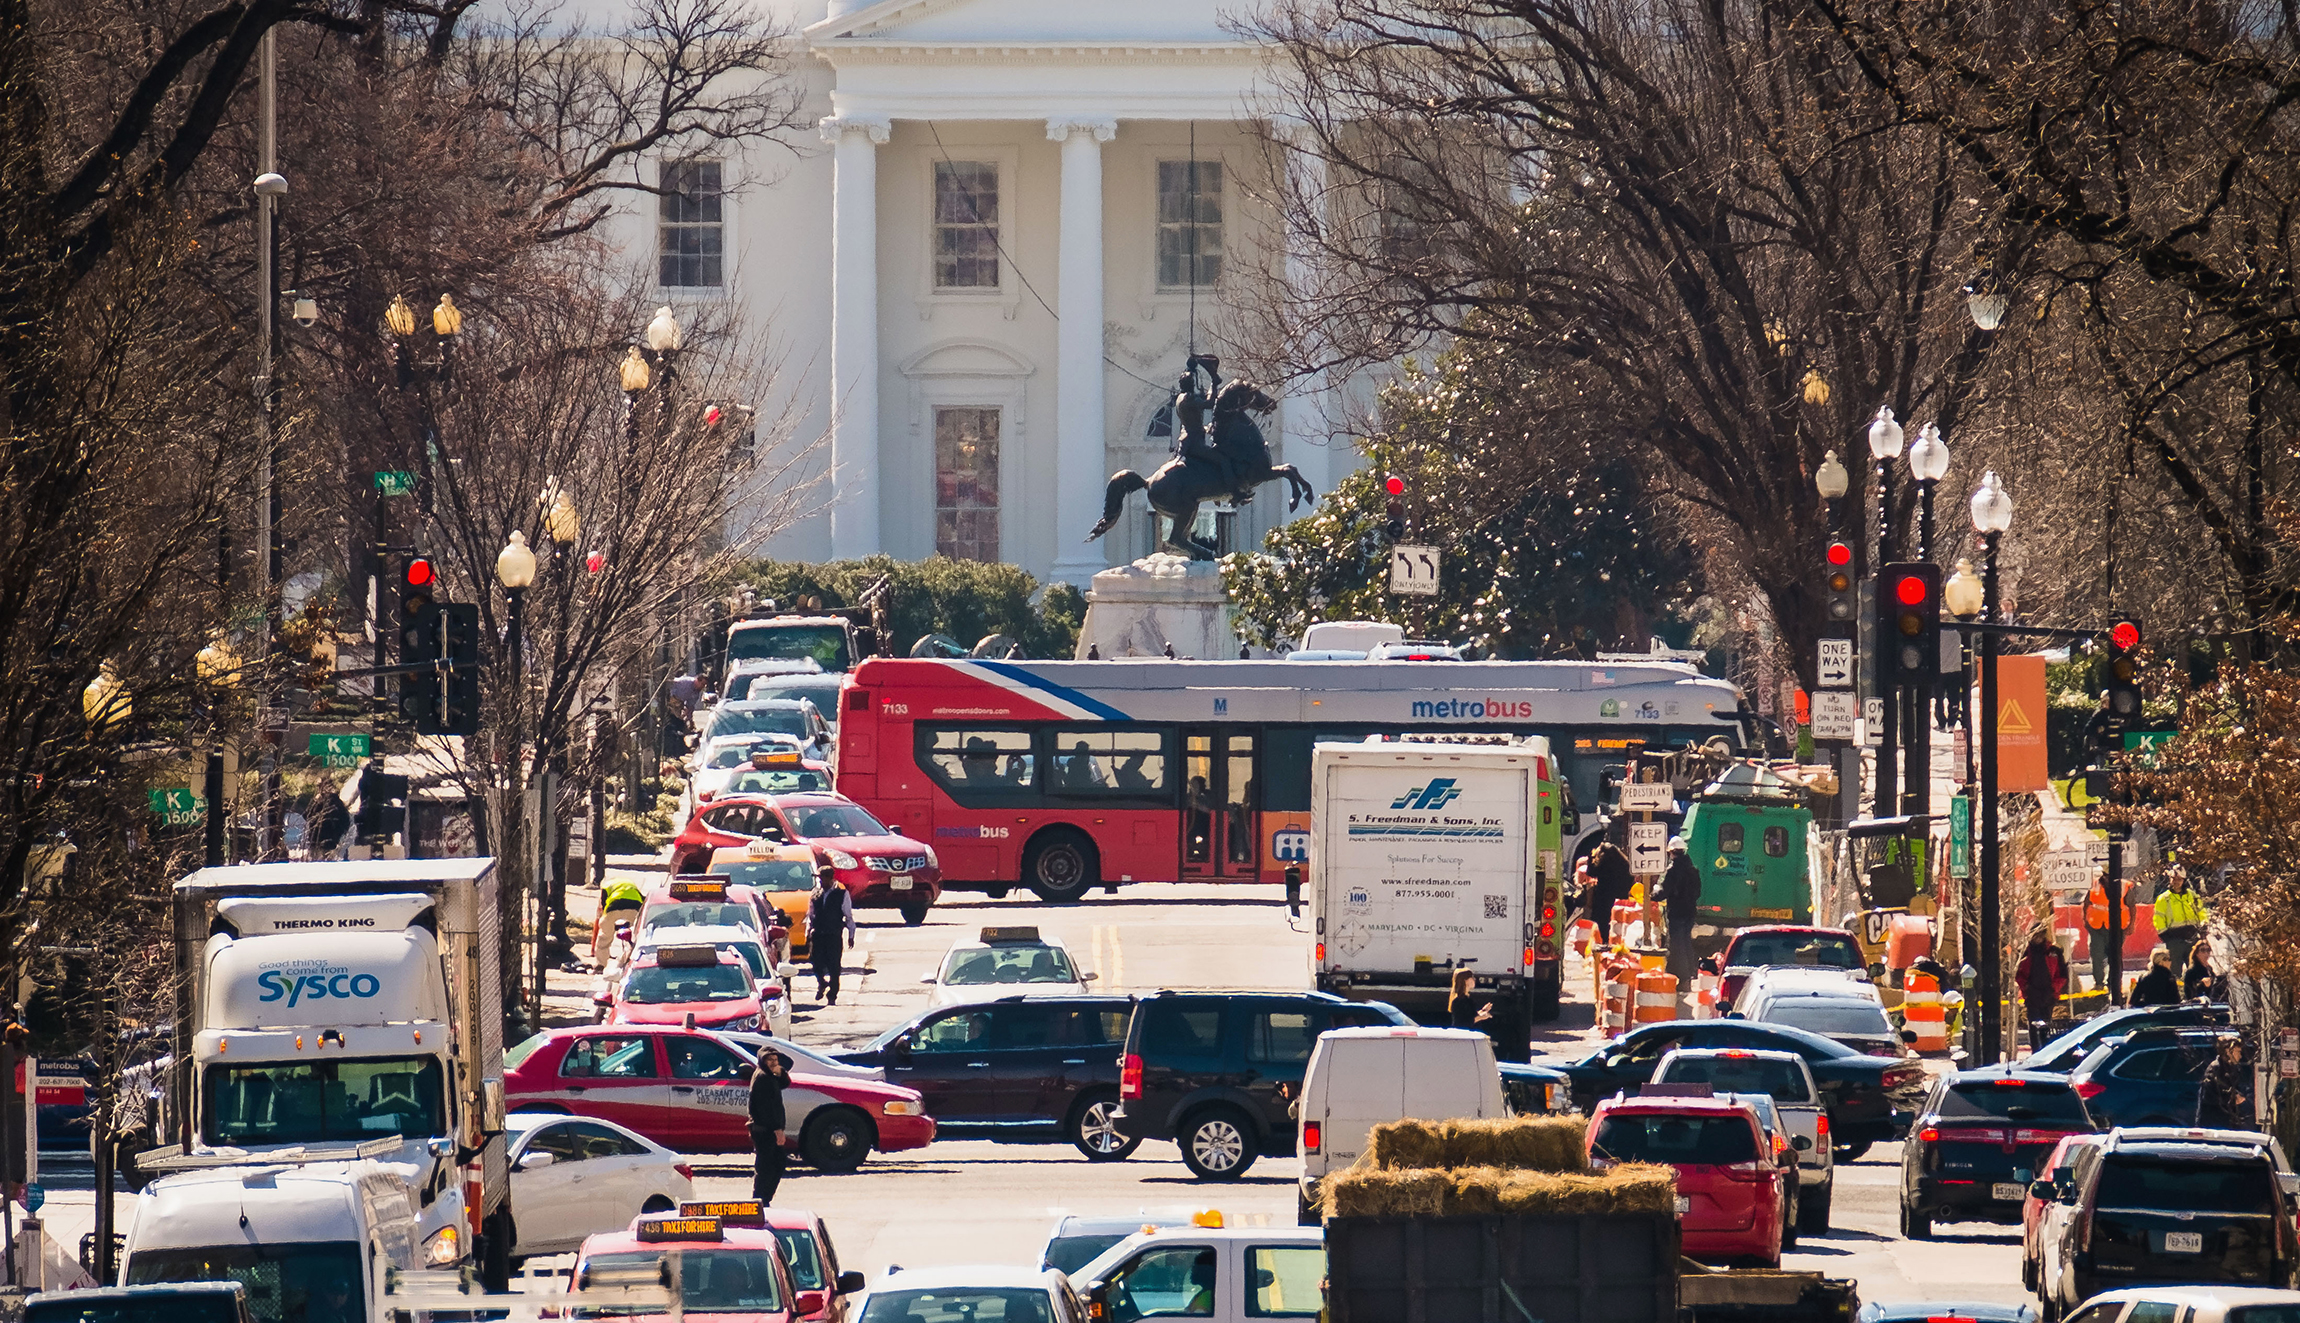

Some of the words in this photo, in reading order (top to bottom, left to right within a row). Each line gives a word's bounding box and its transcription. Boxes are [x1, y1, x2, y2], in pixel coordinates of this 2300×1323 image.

[1822, 644, 1847, 655] ONE
[1822, 657, 1848, 667] WAY
[1828, 695, 1839, 703] NO
[883, 704, 908, 714] 7133
[1412, 697, 1532, 718] metrobus
[1823, 705, 1846, 713] TURN
[1869, 702, 1884, 713] ON
[328, 738, 342, 753] K
[2141, 735, 2155, 750] K
[326, 754, 357, 767] 1500
[1624, 787, 1671, 797] PEDESTRIANS
[167, 792, 182, 808] K
[1349, 814, 1360, 823] S.
[1365, 815, 1426, 824] Freedman
[1430, 816, 1439, 824] &
[1443, 816, 1478, 826] Sons,
[936, 825, 1010, 838] metrobus
[1633, 829, 1662, 839] KEEP
[2087, 844, 2135, 854] PEDESANS
[1634, 860, 1660, 869] LEFT
[1381, 877, 1471, 886] www.sfreedman.com
[2048, 872, 2086, 883] CLOSED
[1350, 892, 1367, 903] 100
[1395, 890, 1455, 899] 877.955.0001
[273, 920, 334, 929] THERMO
[338, 918, 375, 928] KING
[1368, 924, 1414, 932] MARYLAND
[1445, 925, 1484, 934] VIRGINIA
[1868, 913, 1896, 943] CA
[258, 960, 290, 970] Good
[292, 959, 328, 968] things
[286, 967, 319, 976] come
[321, 966, 348, 975] from
[258, 970, 380, 1008] Sysco
[40, 1061, 80, 1070] metrobus
[696, 1088, 733, 1097] PLEASANT
